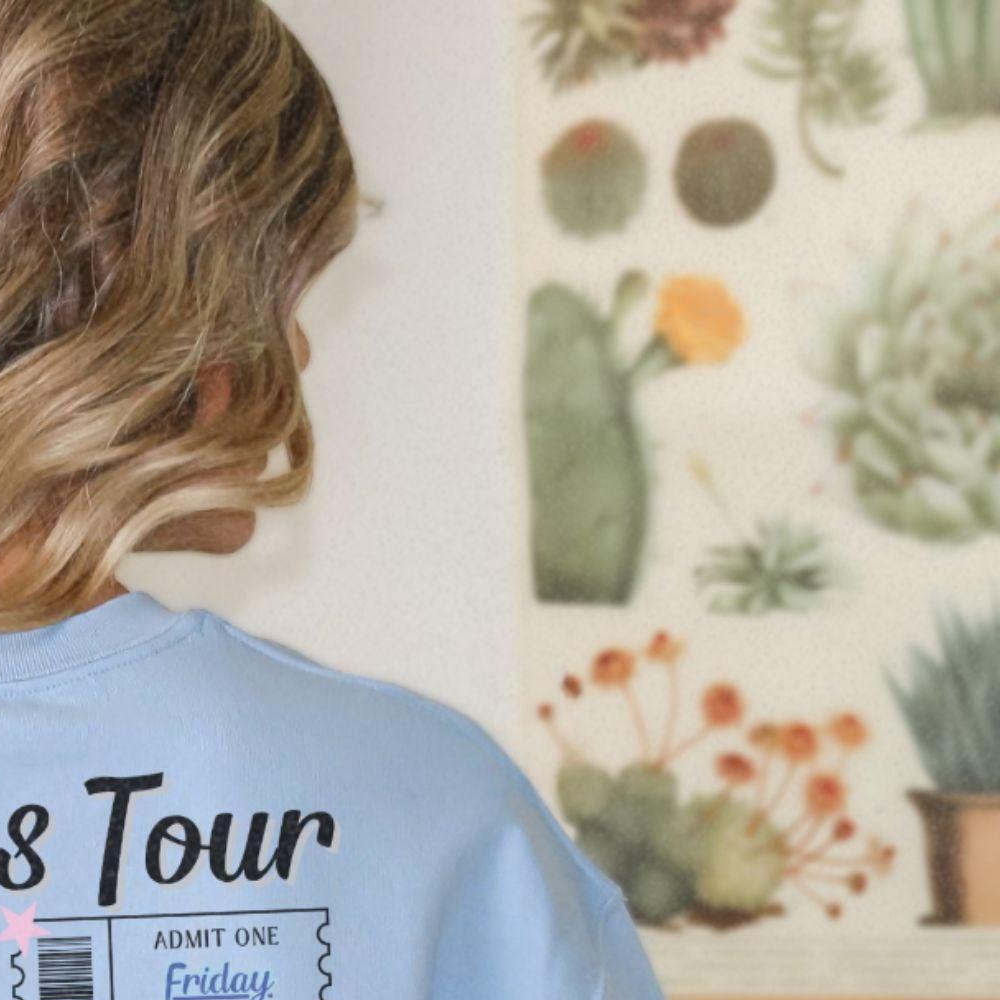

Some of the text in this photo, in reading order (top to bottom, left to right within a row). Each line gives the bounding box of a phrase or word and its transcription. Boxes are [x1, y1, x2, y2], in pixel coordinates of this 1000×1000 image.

[83, 772, 336, 907] Tour
[153, 926, 280, 950] ADMIT ONE
